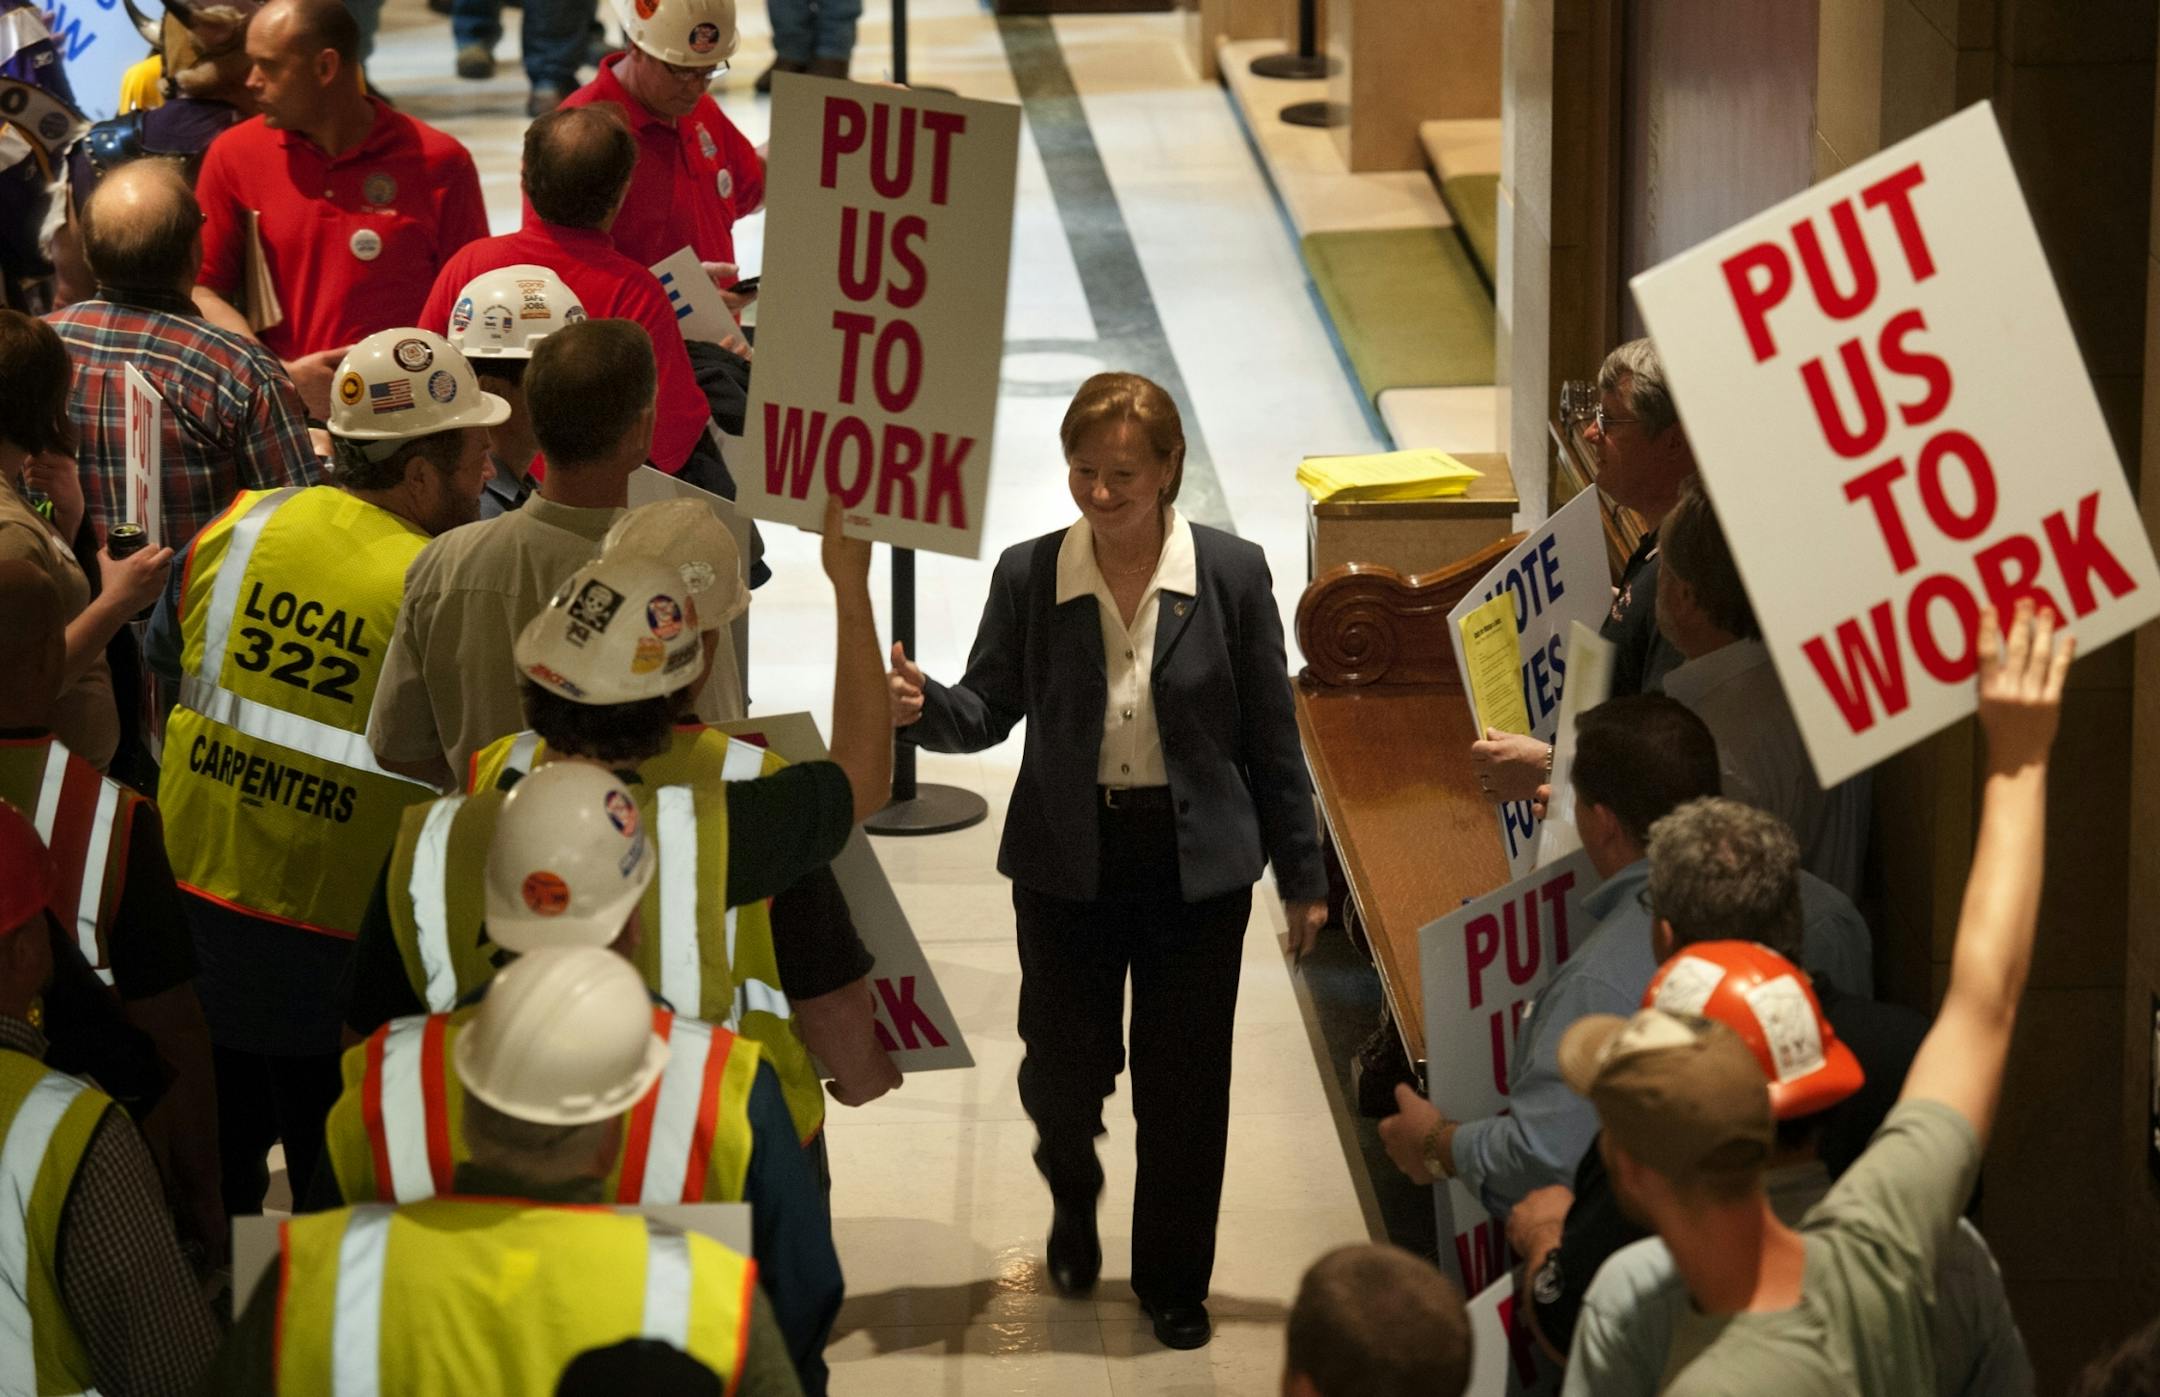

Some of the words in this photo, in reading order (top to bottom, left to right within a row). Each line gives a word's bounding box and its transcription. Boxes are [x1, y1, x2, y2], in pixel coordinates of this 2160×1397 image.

[819, 96, 967, 205] PUT
[837, 205, 928, 309] US
[1720, 161, 1938, 364] PUT
[833, 309, 923, 414] TO
[1799, 308, 1954, 460] US
[132, 383, 153, 477] PUT
[763, 401, 976, 531] WORK
[1842, 429, 1998, 576] TO
[244, 581, 370, 658] LOCAL
[1484, 532, 1565, 635] OTE
[1801, 489, 2139, 737] WORK
[234, 626, 361, 705] 322
[189, 734, 357, 824] CARPENTERS
[1465, 869, 1576, 1010] PUT
